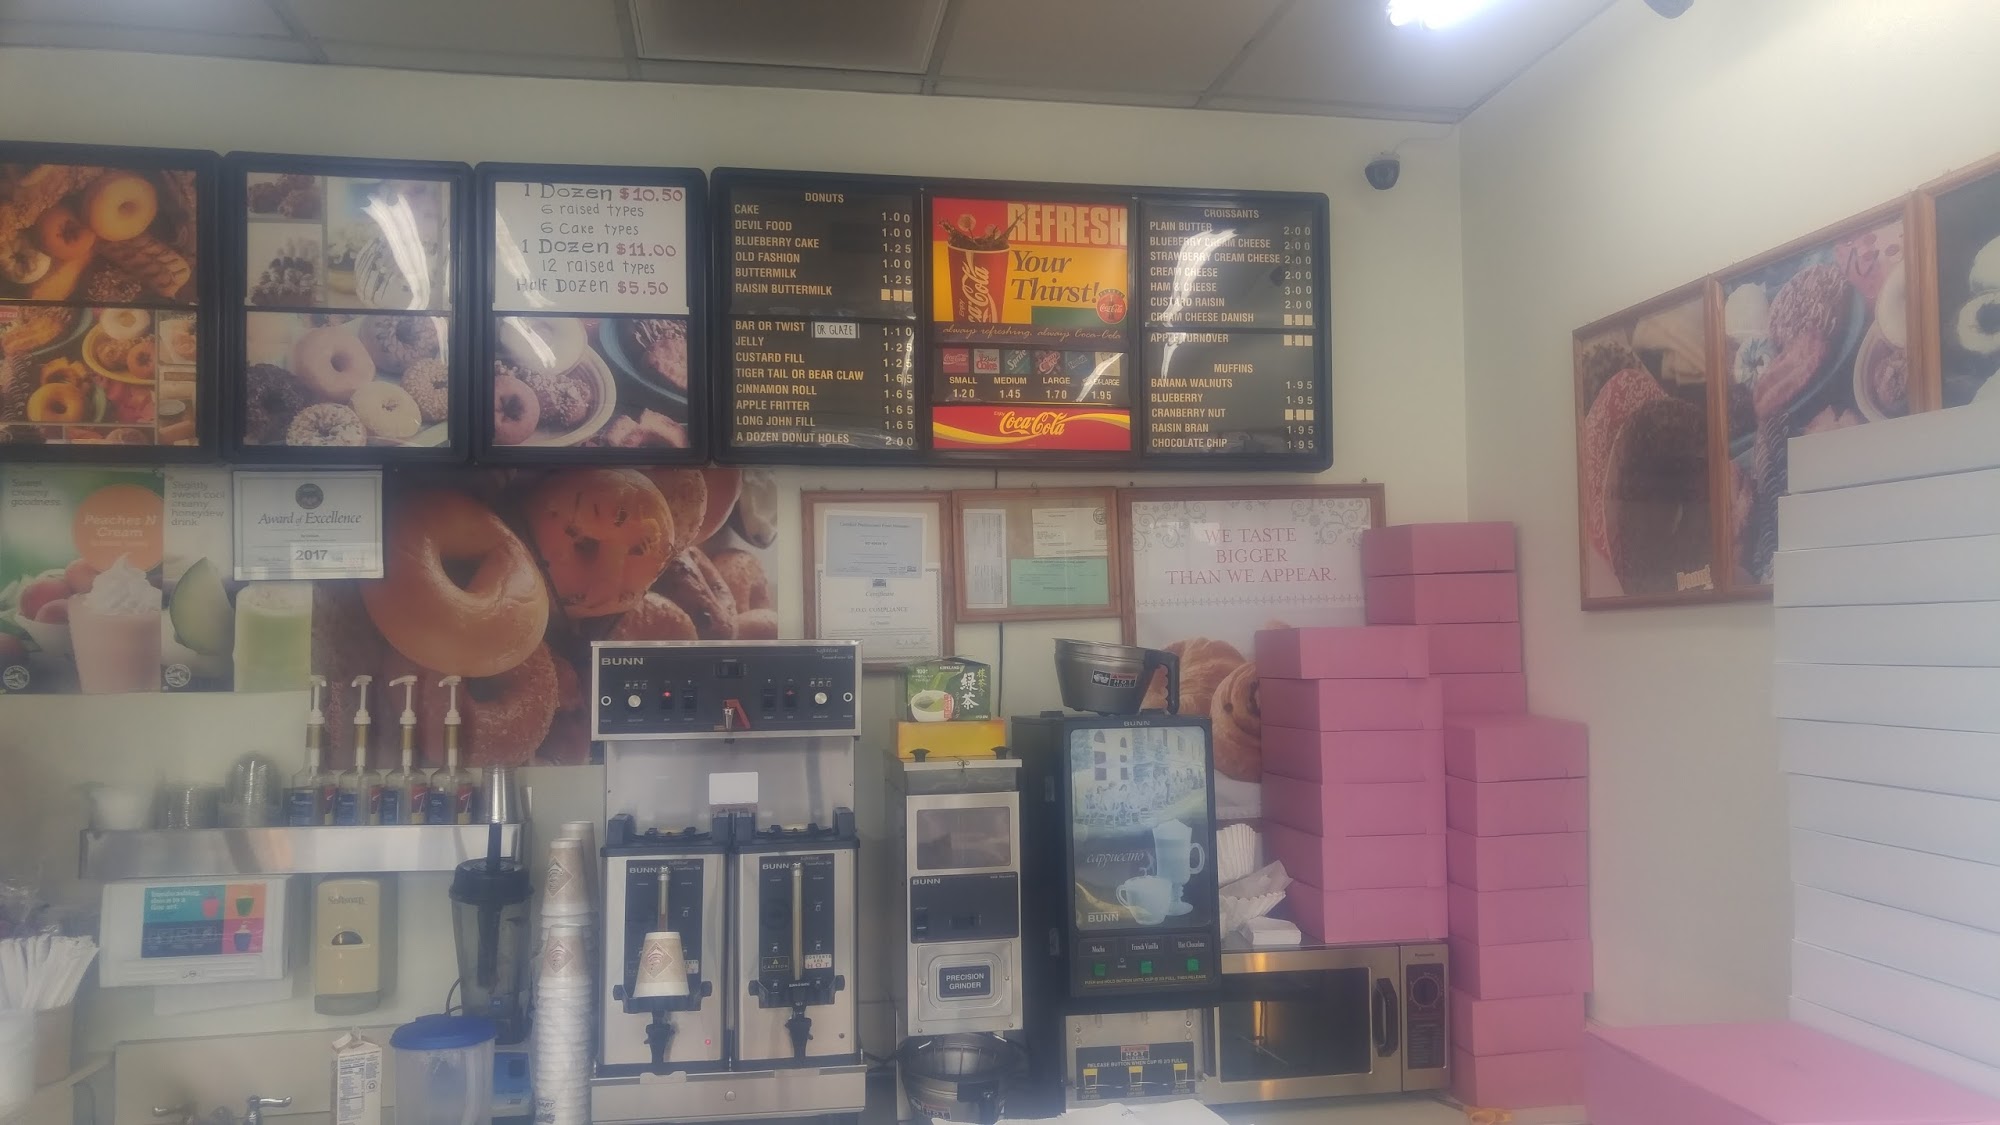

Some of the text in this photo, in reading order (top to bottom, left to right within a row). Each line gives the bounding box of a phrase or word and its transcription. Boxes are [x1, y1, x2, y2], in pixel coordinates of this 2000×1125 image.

[525, 184, 683, 201] 1 Dozen $10.50
[805, 193, 844, 202] DONUTS
[542, 204, 644, 217] 6 raised types
[735, 205, 759, 214] CAKE
[1204, 209, 1259, 218] CROISSANTS
[882, 212, 910, 223] 1.00
[541, 223, 639, 235] 6 Cake types
[735, 221, 792, 230] DEVIL FOOD
[1008, 203, 1127, 245] REFRESH
[1150, 222, 1212, 231] PLAIN BUTTER
[882, 228, 911, 238] 1.00
[1284, 227, 1311, 236] 2.00
[736, 237, 819, 248] BLUEBERRY CAKE
[1150, 237, 1271, 248] BLUEBERRY CREAM CHEESE
[1285, 242, 1310, 250] 2.00
[522, 239, 676, 257] 1 Dozen $11.00
[883, 243, 911, 253] 1.25
[736, 252, 800, 263] OLD FASHION
[1011, 250, 1072, 273] Your
[1150, 252, 1280, 263] STRAWBERRY CREAM CHEESE
[1285, 256, 1311, 264] 2.00
[543, 259, 655, 274] 12 raised types
[883, 259, 911, 269] 1.00
[736, 268, 796, 278] BUTTERMILK
[1151, 267, 1218, 277] CREAM CHEESE
[1285, 271, 1311, 280] 2.00
[883, 275, 911, 285] 1.25
[517, 279, 668, 295] Half Dozen $5.50
[736, 284, 832, 295] RAISIN BUTTERMILK
[1011, 278, 1099, 303] Thirst!
[1151, 282, 1170, 291] HAM
[1184, 283, 1216, 292] CHEESE
[1285, 286, 1311, 295] 3.00
[1151, 297, 1224, 306] CUSTARD RAISIN
[1285, 301, 1311, 309] 2.00
[1151, 312, 1254, 322] CREAM CHEESE DANISH
[736, 321, 805, 331] BAR OR TWIST
[817, 324, 853, 335] OR GLAZE
[883, 327, 911, 336] 1.10
[943, 325, 976, 339] always
[1038, 328, 1071, 339] always
[1075, 329, 1121, 339] Coca-Cola
[736, 337, 764, 346] JELLY
[1151, 334, 1228, 343] APPLE TURNOVER
[736, 353, 804, 363] CUSTARD FILL
[1007, 350, 1026, 370] Sprite
[1214, 364, 1253, 373] MUFFINS
[736, 369, 864, 380] TIGER TAIL OR BEAR CLAW
[994, 377, 1027, 385] MEDIUM
[1151, 379, 1233, 388] BANANA WALNUTS
[1286, 381, 1312, 389] 1.95
[736, 384, 817, 395] CINNAMON ROLL
[884, 390, 912, 399] 1.65
[953, 389, 975, 398] 1.20
[1000, 389, 1021, 398] 1.45
[1046, 390, 1067, 399] 1.70
[1092, 391, 1111, 400] 1.95
[1151, 394, 1203, 402] BLUEBERRY
[1286, 396, 1313, 404] 1.95
[736, 400, 810, 410] APPLE FRITTER
[885, 406, 913, 415] 1.65
[1152, 409, 1226, 418] CRANBERRY NUT
[737, 416, 815, 426] LONG JOHN FILL
[885, 421, 913, 430] 1.65
[999, 411, 1068, 435] Coca-Cola
[1152, 424, 1208, 432] RAISIN BRAN
[1287, 426, 1313, 434] 1.95
[737, 432, 849, 443] A DOZEN DONUT HOLES
[1152, 439, 1227, 447] CHOCOLATE CHIP
[1287, 441, 1313, 449] 1.95
[258, 512, 294, 524] Award
[306, 511, 361, 524] Excellence
[1205, 528, 1297, 543] WE TASTE
[296, 550, 328, 560] 2017
[1216, 549, 1288, 563] BIGGER
[1166, 568, 1337, 584] THAN WE APPEAR.
[1087, 851, 1144, 865] cappuccino
[1088, 914, 1119, 922] BUNN
[946, 973, 984, 982] PRECISION
[949, 981, 981, 989] GRINDER
